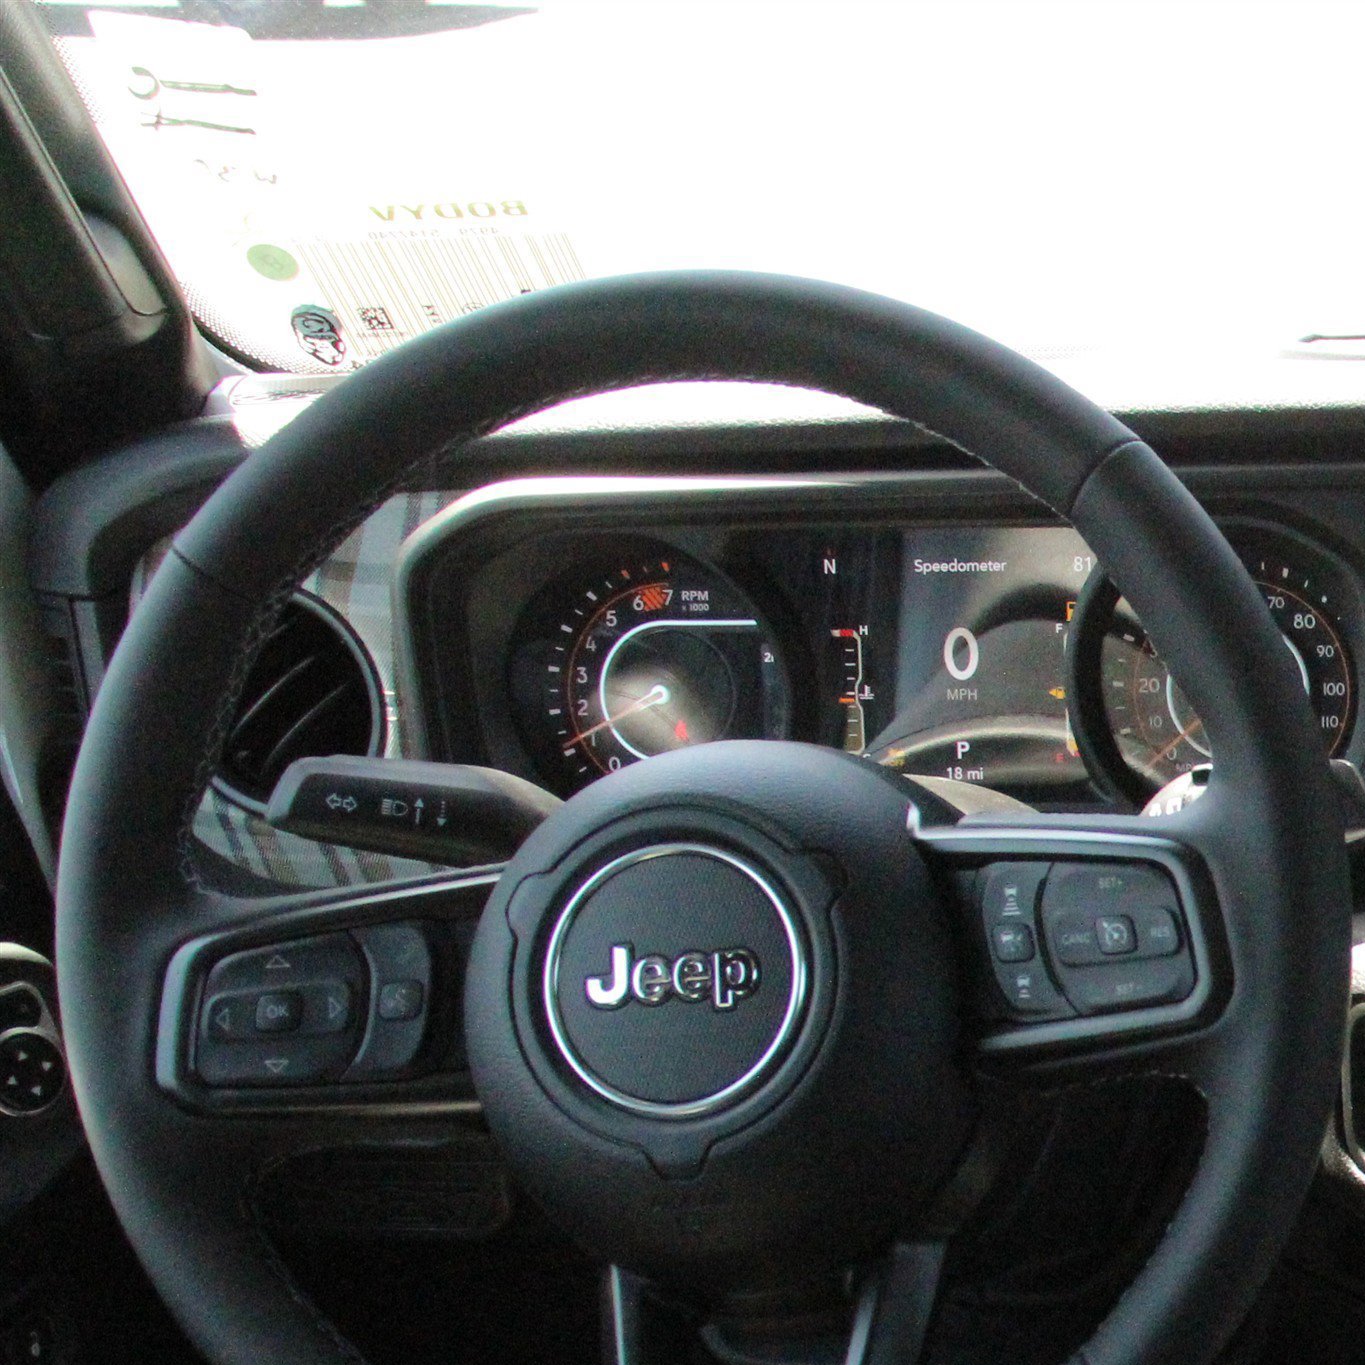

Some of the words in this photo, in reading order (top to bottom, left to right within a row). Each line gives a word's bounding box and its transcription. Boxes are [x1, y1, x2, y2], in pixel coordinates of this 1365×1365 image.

[823, 558, 837, 575] N
[913, 559, 1007, 576] Speedometer
[633, 595, 645, 611] 6
[662, 589, 674, 606] 7
[681, 590, 709, 601] RPM
[1267, 596, 1286, 609] 70
[605, 610, 617, 627] 5
[1293, 614, 1316, 629] 80
[859, 625, 868, 635] H
[586, 636, 597, 651] 4
[944, 627, 979, 681] 0
[1316, 645, 1335, 658] 90
[576, 667, 588, 683] 3
[1138, 679, 1160, 693] 20
[1323, 683, 1345, 696] 100
[946, 689, 978, 701] MPH
[577, 700, 588, 716] 2
[1321, 716, 1339, 728] 110
[956, 742, 971, 759] P
[946, 768, 963, 780] 18
[967, 767, 984, 780] mi
[585, 945, 761, 1010] Jeep
[265, 1005, 288, 1018] OK
